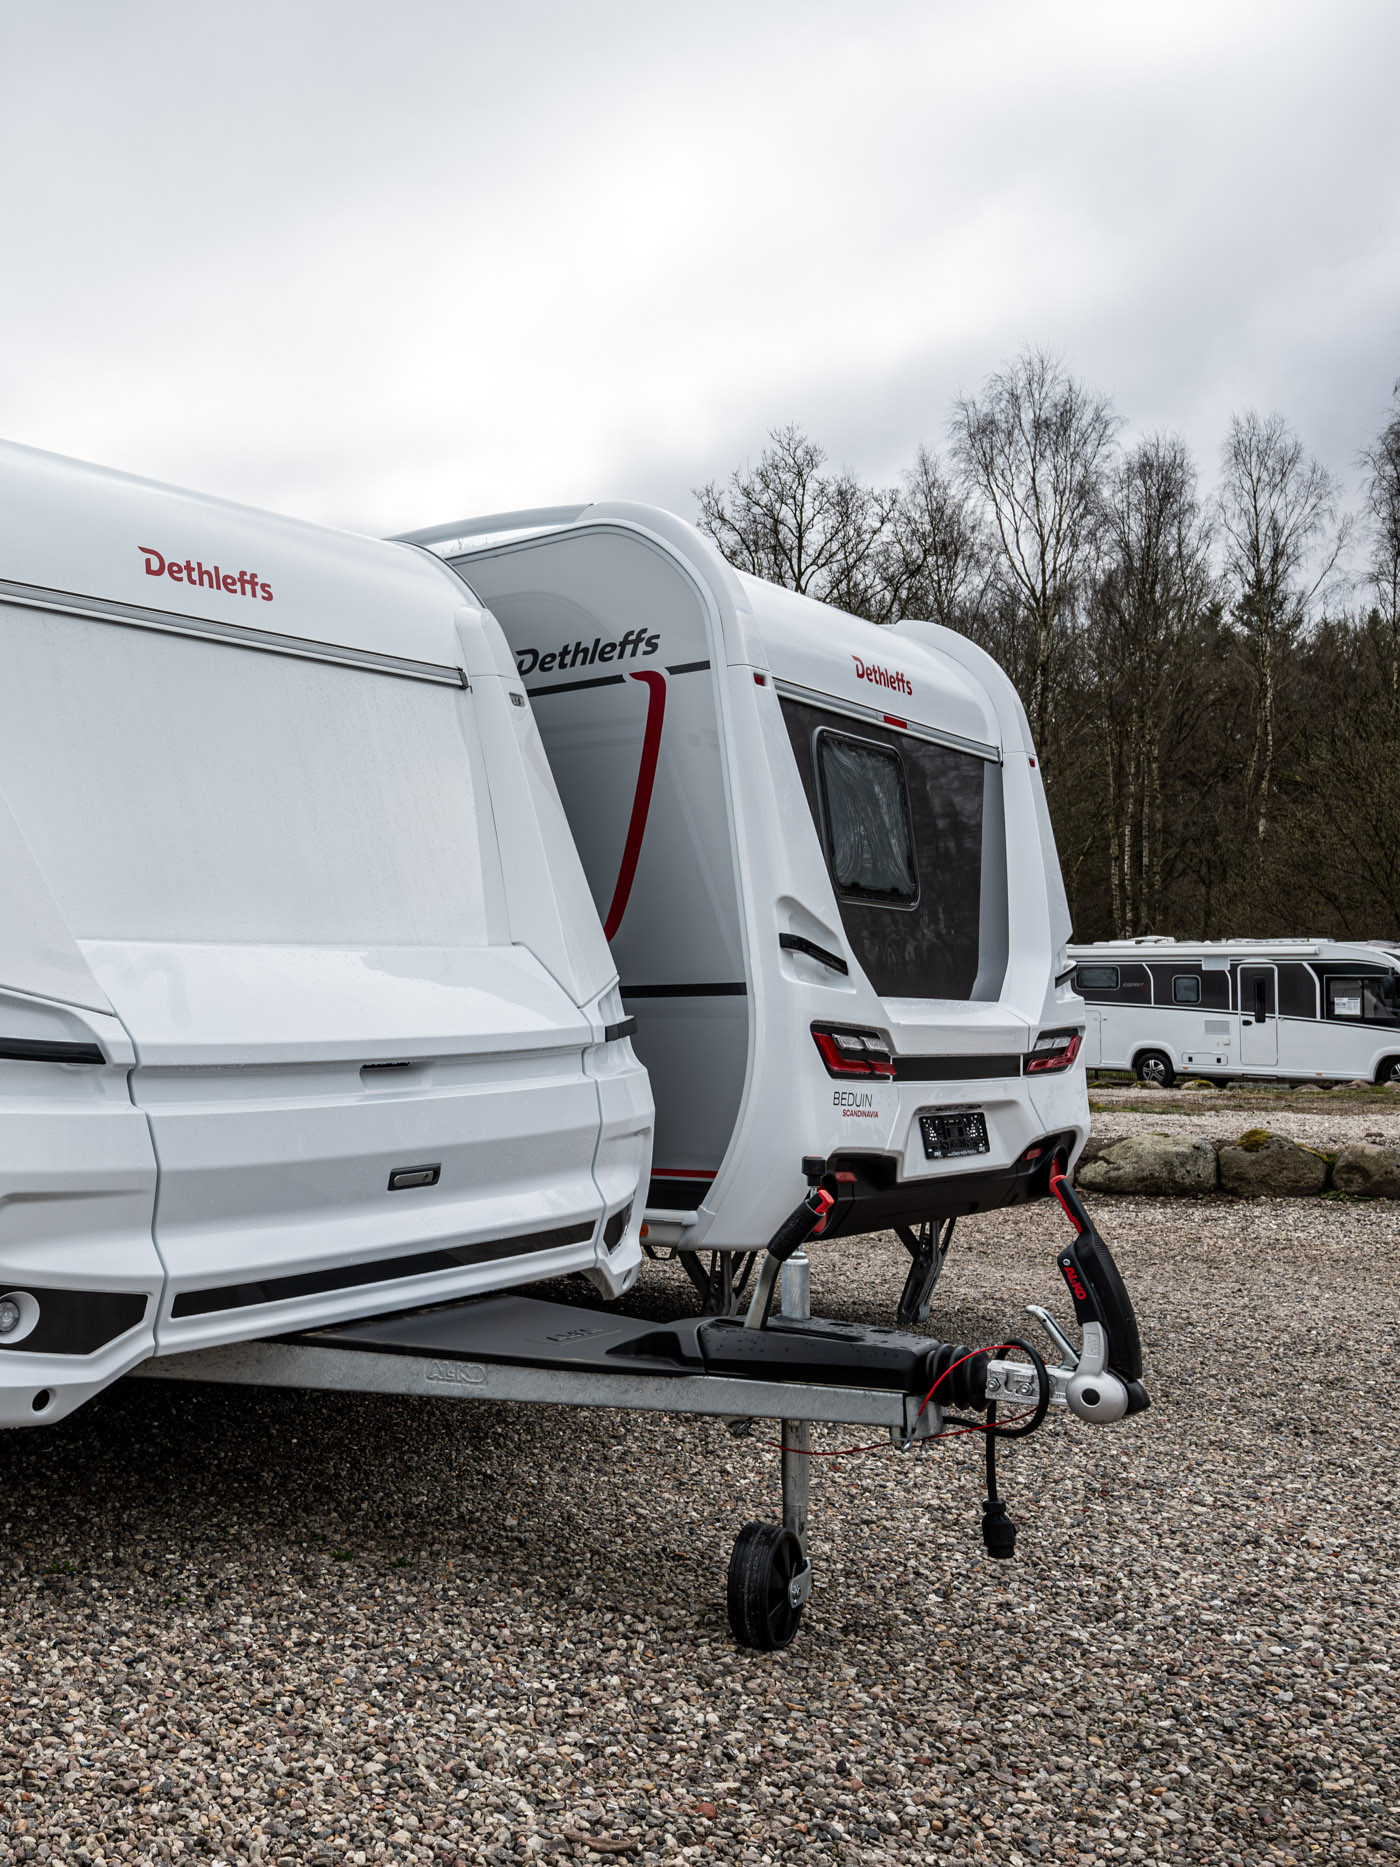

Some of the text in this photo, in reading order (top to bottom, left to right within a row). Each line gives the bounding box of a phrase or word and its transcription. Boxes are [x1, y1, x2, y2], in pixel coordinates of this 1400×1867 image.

[137, 546, 274, 602] Dethleffs
[514, 628, 661, 676] Dethleffs
[851, 655, 913, 696] Dethleffs
[833, 1091, 873, 1108] BEDUIN
[842, 1109, 879, 1118] SCANDINAVIA
[1063, 1267, 1087, 1300] AL-KO
